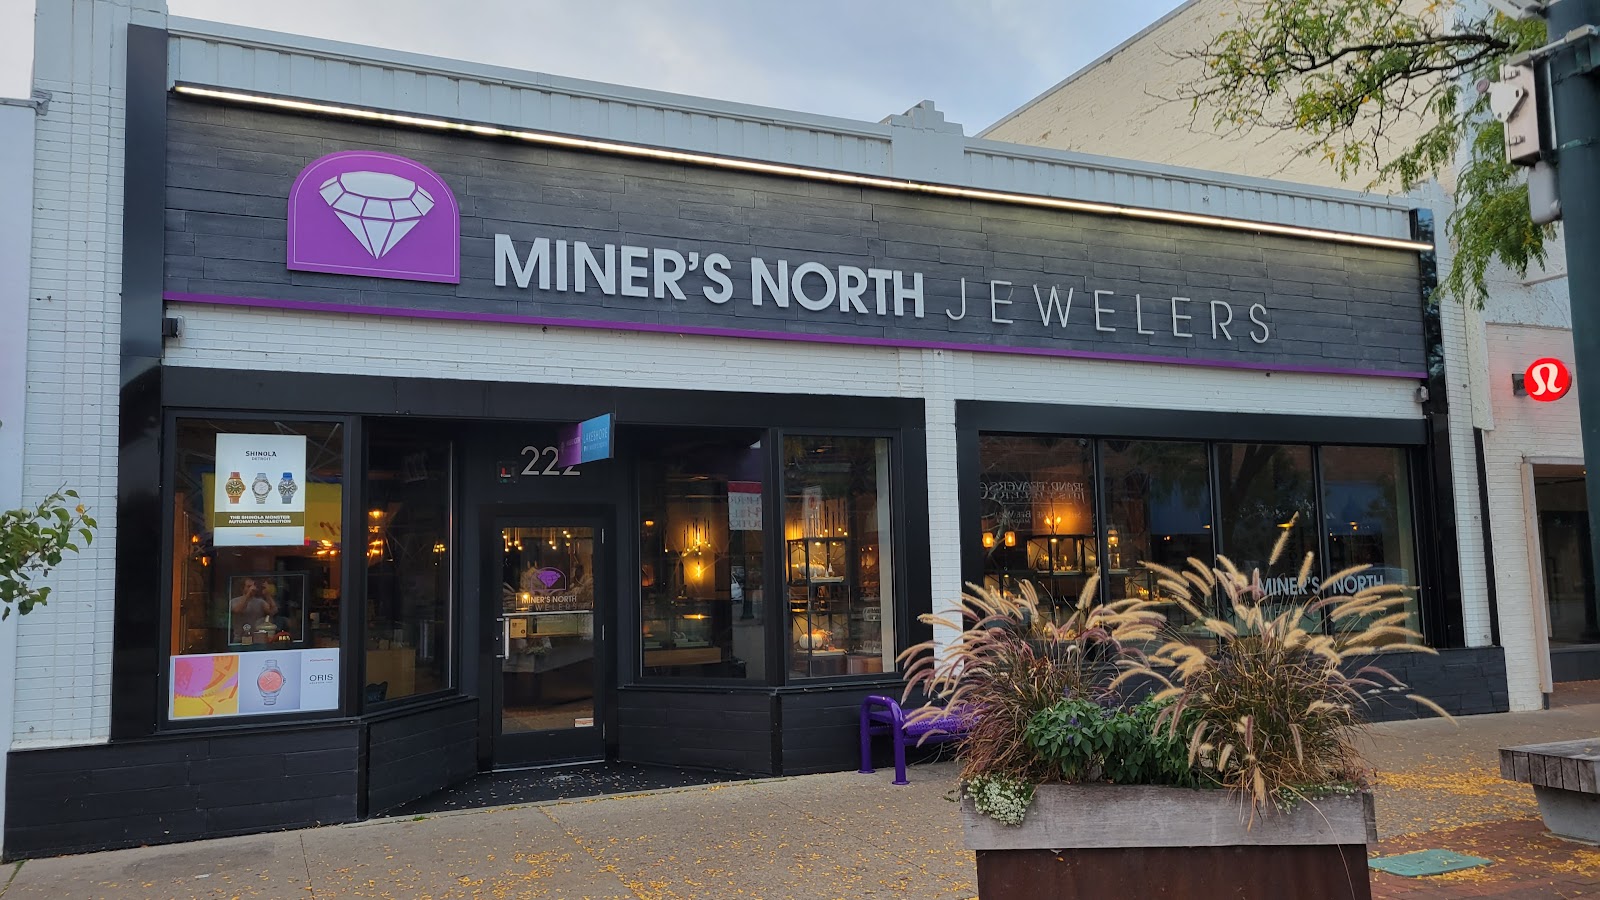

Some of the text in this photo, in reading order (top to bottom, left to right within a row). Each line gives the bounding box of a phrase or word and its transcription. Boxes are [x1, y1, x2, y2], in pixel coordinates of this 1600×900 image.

[494, 233, 1270, 344] MINER'S NORTH JEWELERS
[521, 595, 577, 604] MINER'S NORTH
